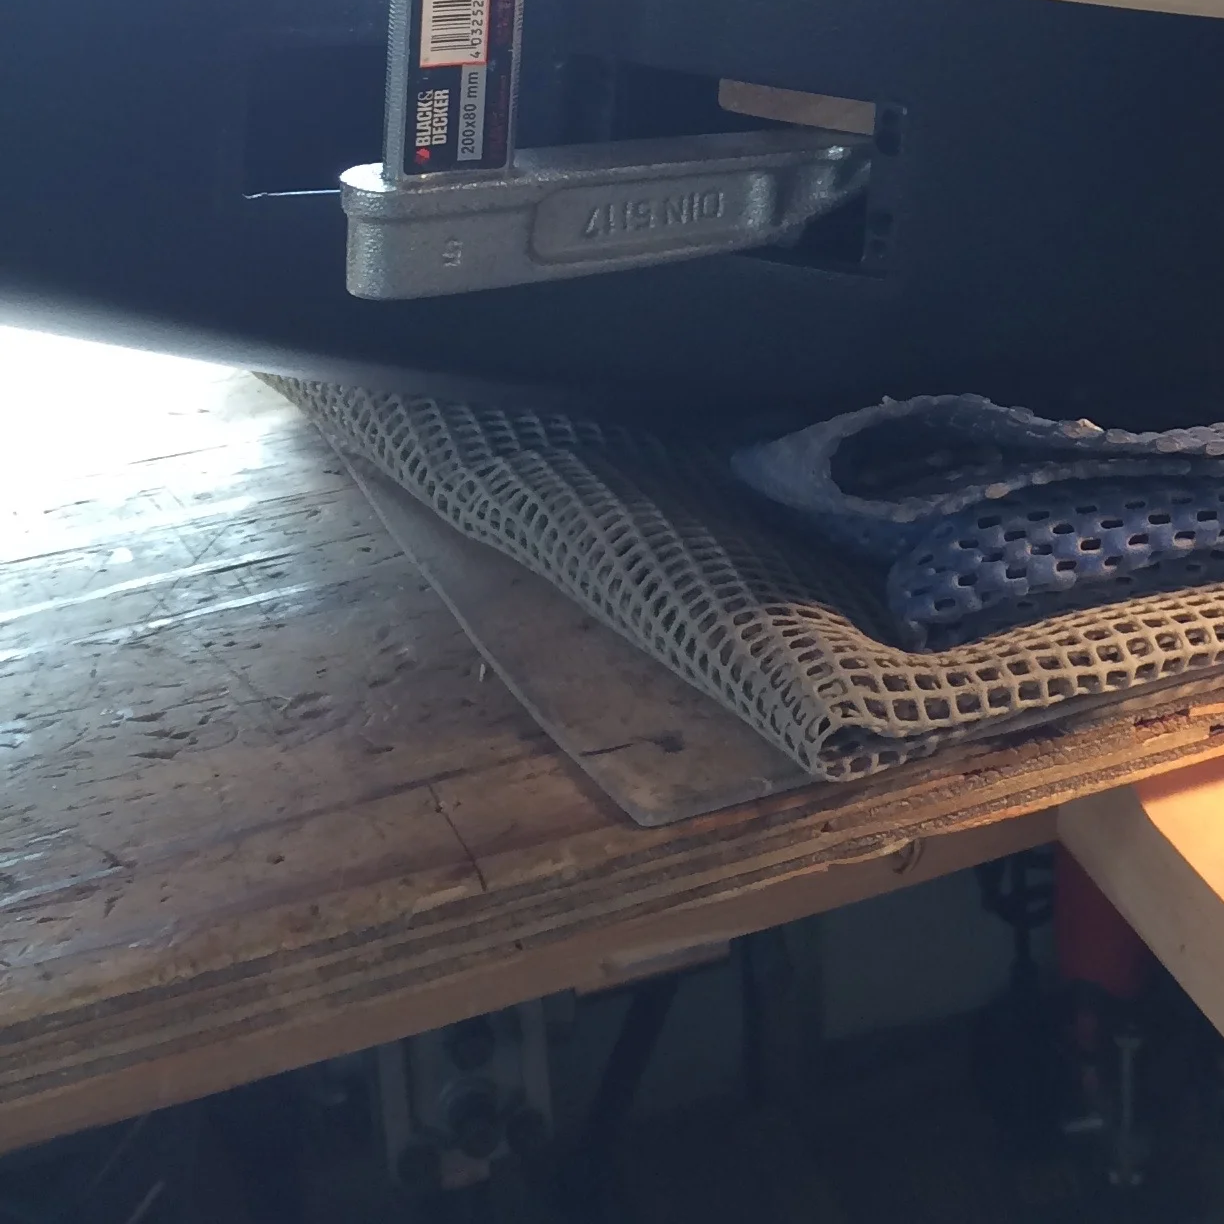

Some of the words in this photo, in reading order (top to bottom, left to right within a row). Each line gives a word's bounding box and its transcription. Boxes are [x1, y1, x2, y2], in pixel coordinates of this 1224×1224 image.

[467, 71, 479, 98] mm
[431, 89, 450, 145] DECKER
[461, 103, 477, 154] 200x80
[664, 191, 725, 225] DIN
